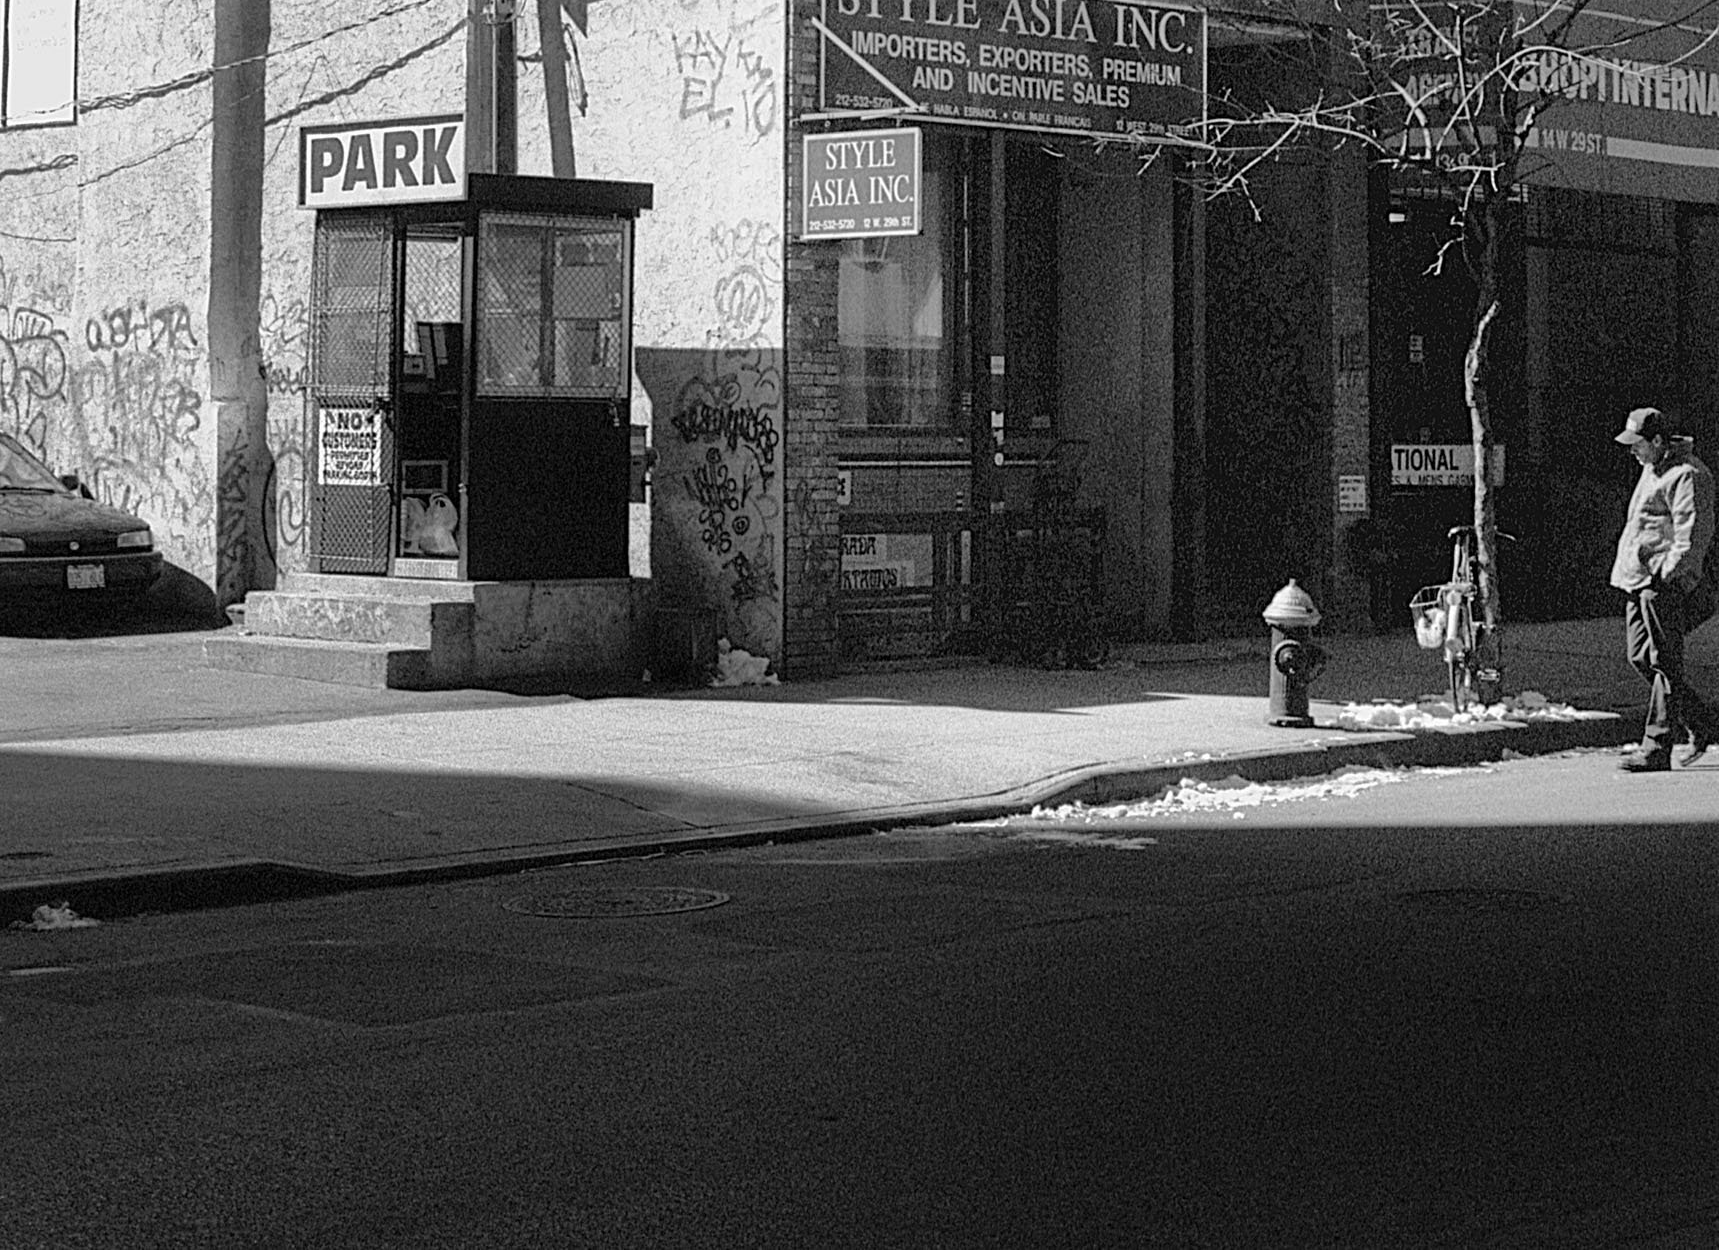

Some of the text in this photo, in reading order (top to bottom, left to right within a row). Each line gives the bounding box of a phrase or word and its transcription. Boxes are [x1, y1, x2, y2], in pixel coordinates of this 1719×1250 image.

[1114, 4, 1193, 54] INC.
[851, 30, 1182, 86] IMPORTERS, EXPORTERS, PREMIUM
[912, 66, 1130, 108] AND INCENTIVE SALES
[933, 103, 960, 116] HABLA
[826, 139, 896, 170] STYLE
[1541, 129, 1554, 148] 14
[1571, 131, 1586, 151] 29
[310, 125, 458, 193] PARK
[808, 174, 914, 207] ASIA INC.
[337, 412, 363, 430] NO
[1394, 448, 1459, 471] TIONAL
